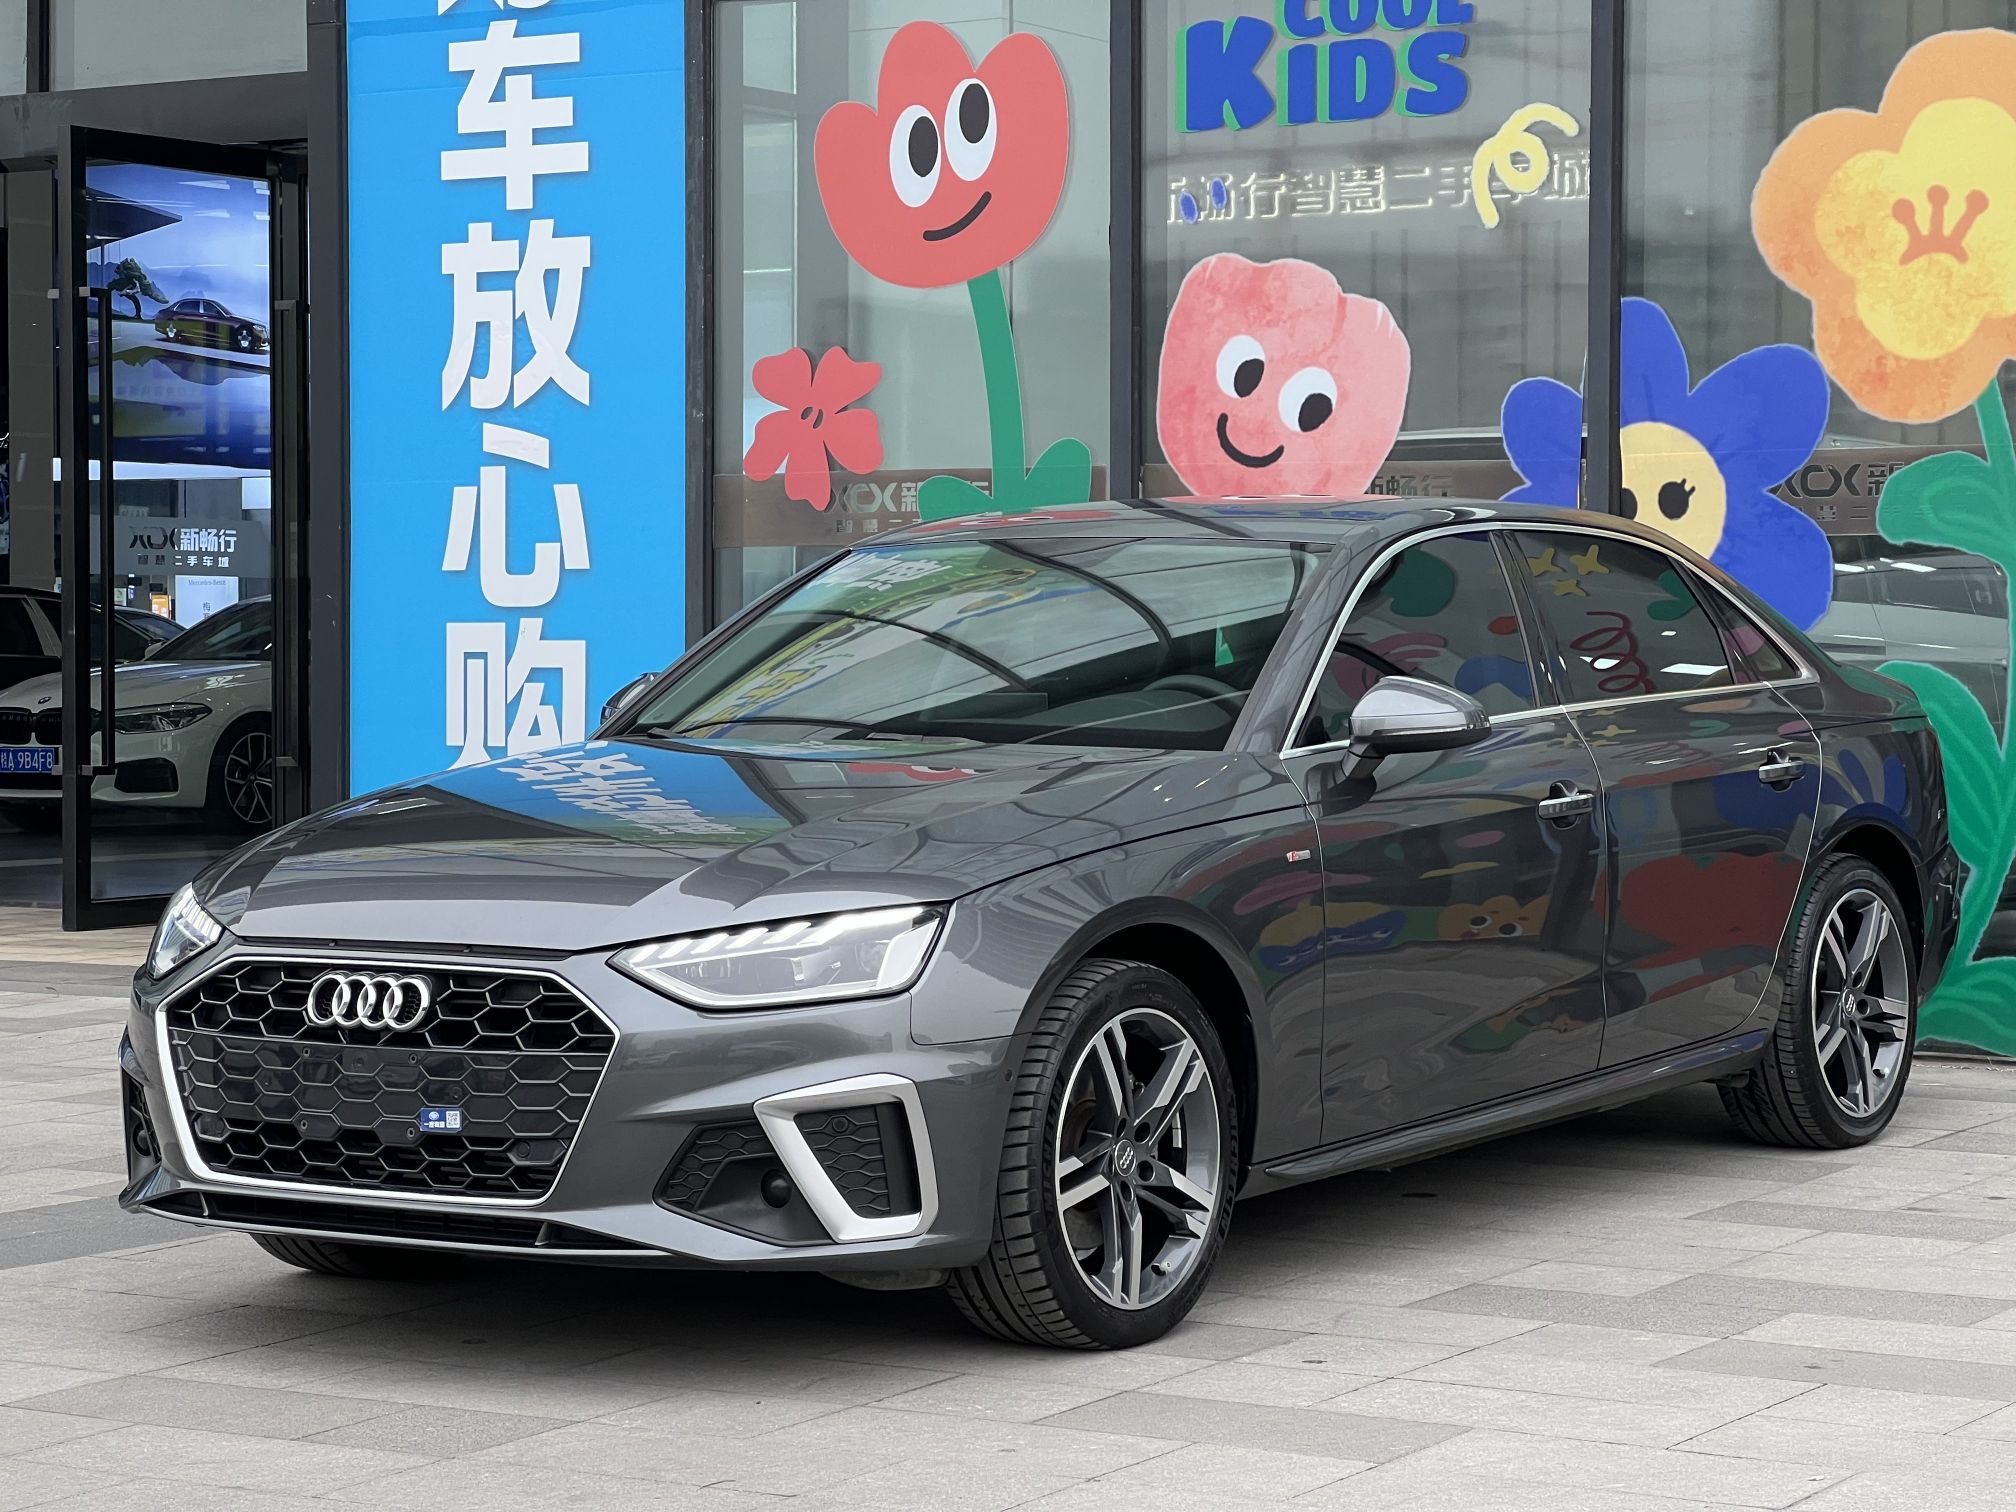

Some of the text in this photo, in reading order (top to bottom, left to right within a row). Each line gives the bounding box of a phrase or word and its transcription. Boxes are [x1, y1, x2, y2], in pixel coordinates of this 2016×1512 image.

[1175, 16, 1470, 133] KIDS
[437, 0, 591, 770] 车放心购
[180, 528, 237, 552] 新畅行
